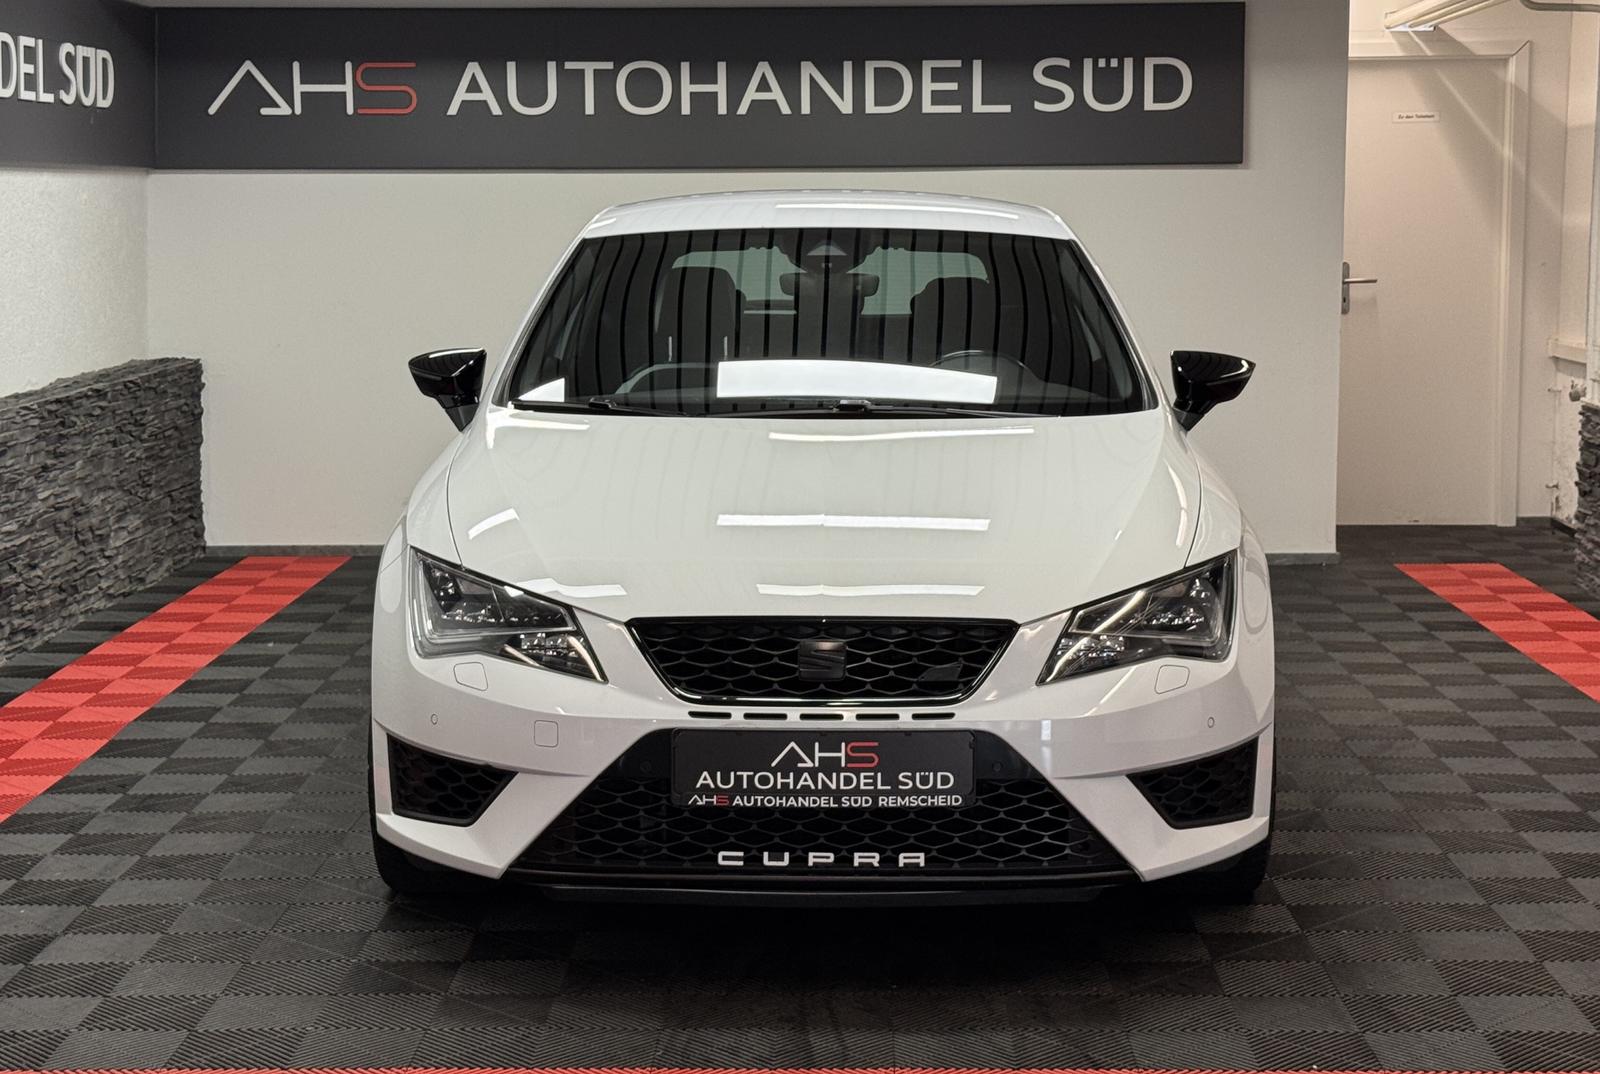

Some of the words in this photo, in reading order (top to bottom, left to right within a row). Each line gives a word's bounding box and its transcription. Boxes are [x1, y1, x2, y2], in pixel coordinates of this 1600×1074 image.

[0, 31, 55, 103] DEL
[58, 42, 115, 108] SÜD
[207, 60, 418, 116] AHS
[446, 59, 1012, 116] AUTOHANDEL
[1032, 57, 1193, 113] SÜD
[770, 741, 880, 768] AHS
[695, 771, 892, 790] AUTOHANDEL
[898, 771, 955, 790] SÜD
[687, 794, 730, 806] AHS
[732, 795, 839, 808] AUTOHANDEL
[841, 796, 873, 808] SÜD
[878, 794, 963, 807] REMSCHEID
[717, 851, 926, 867] CUPRA
